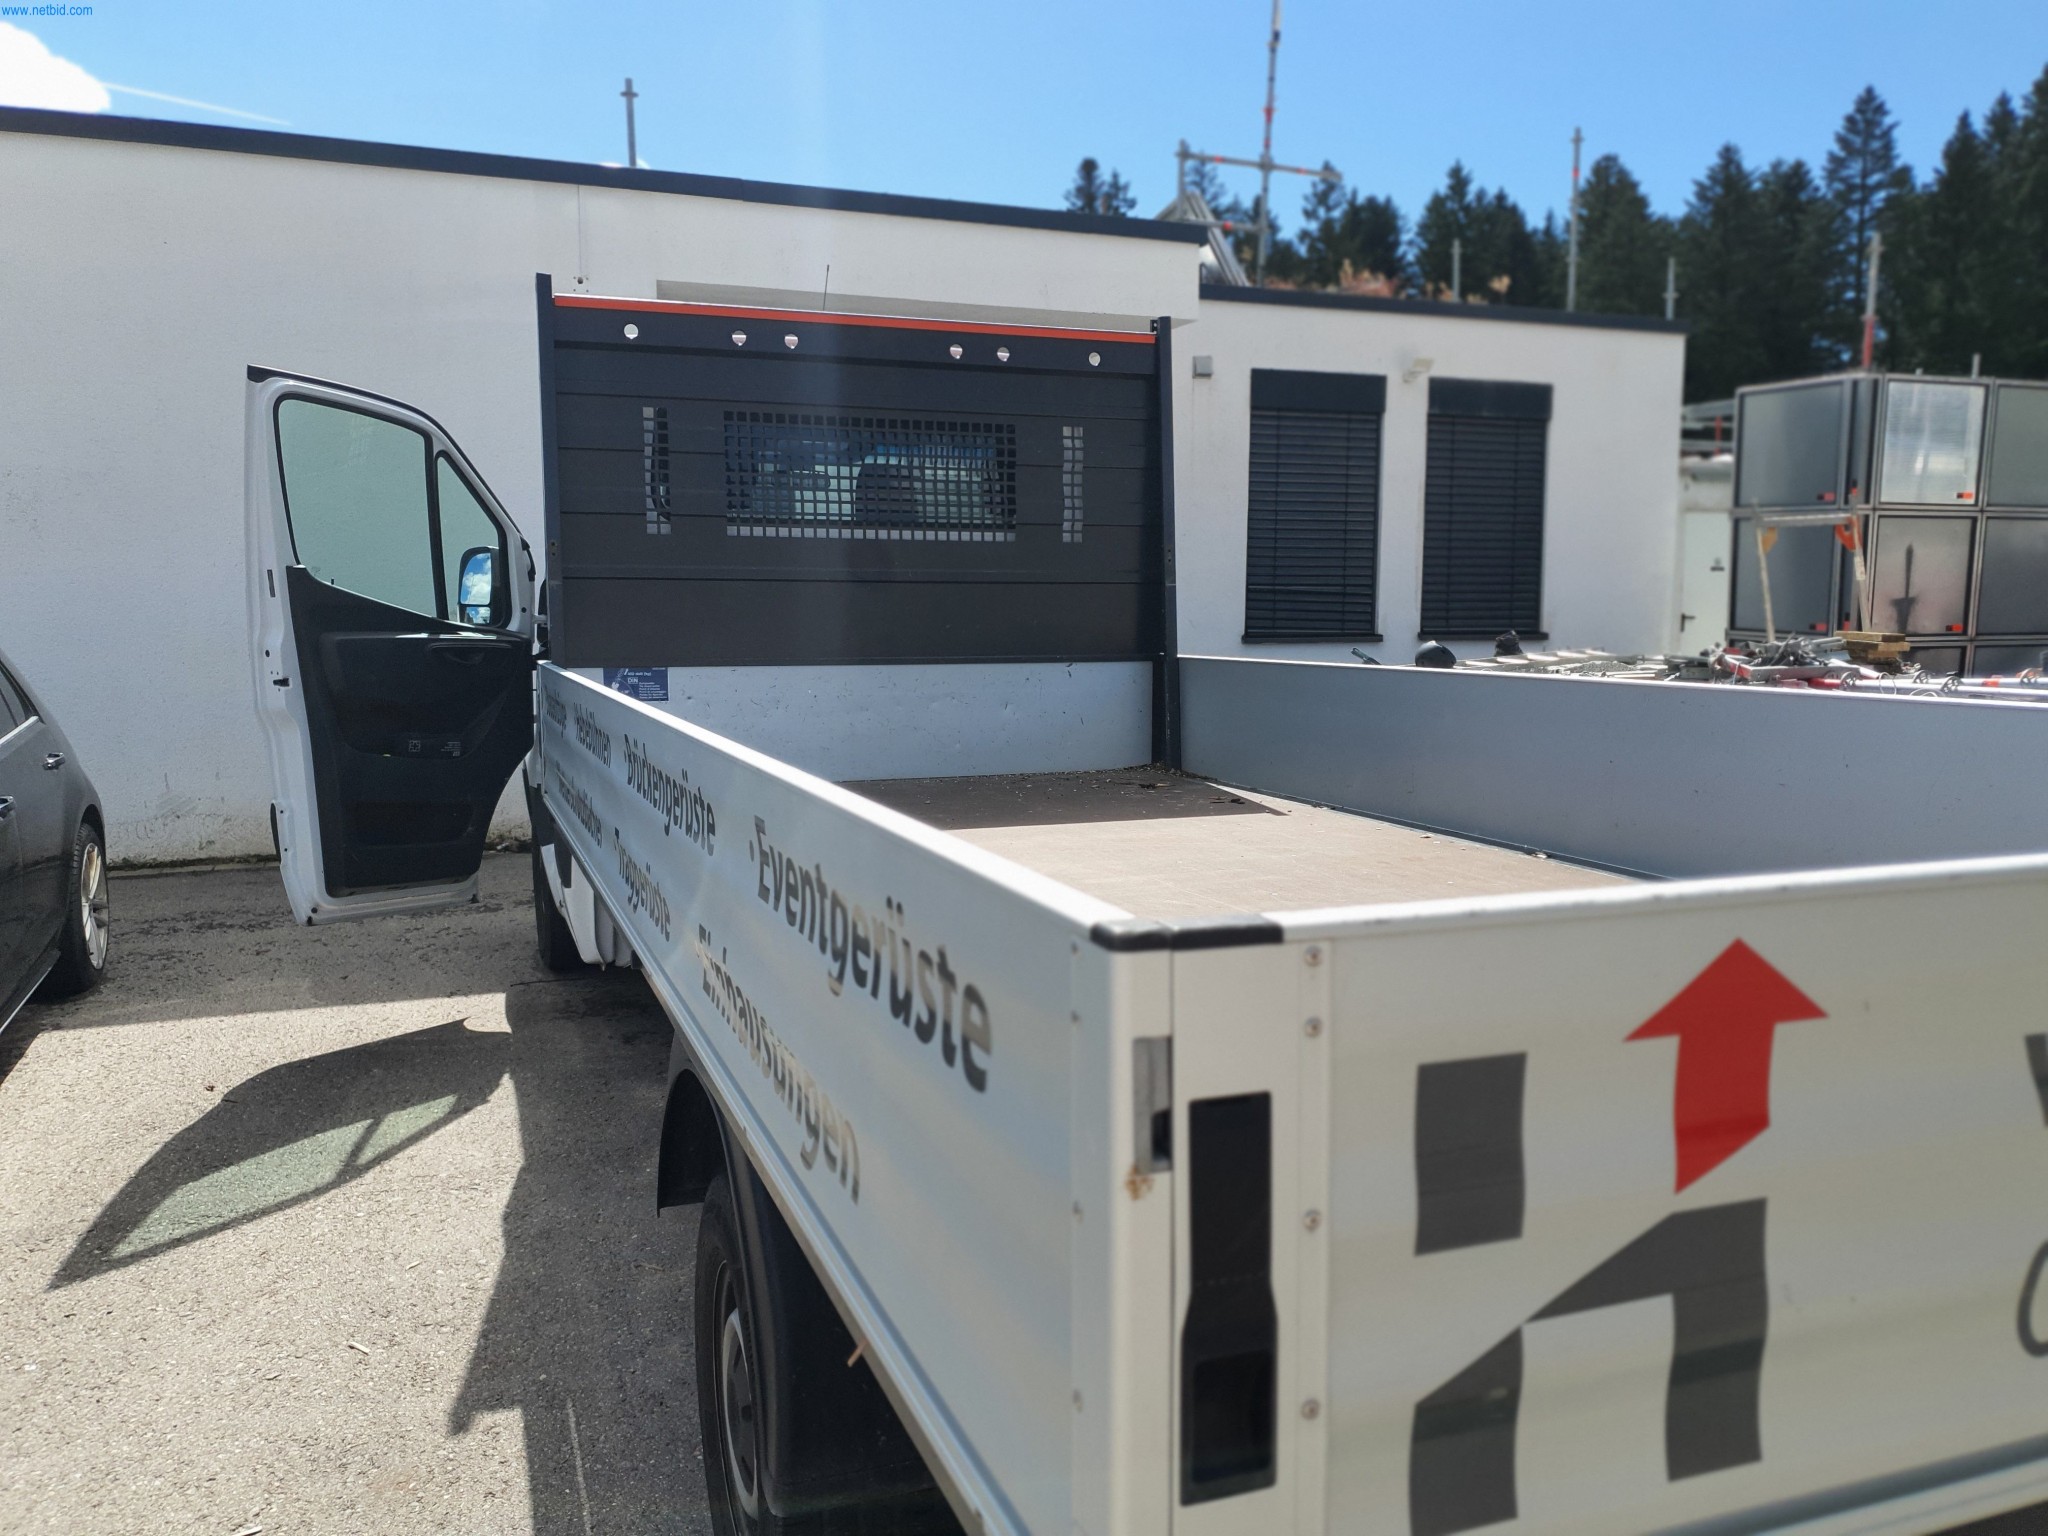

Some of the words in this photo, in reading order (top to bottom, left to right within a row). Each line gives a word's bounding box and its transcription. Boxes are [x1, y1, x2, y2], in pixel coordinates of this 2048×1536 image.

[624, 734, 716, 855] Brückengerüste
[754, 815, 992, 1093] Eventgerüste
[699, 923, 860, 1205] Einhausungen
